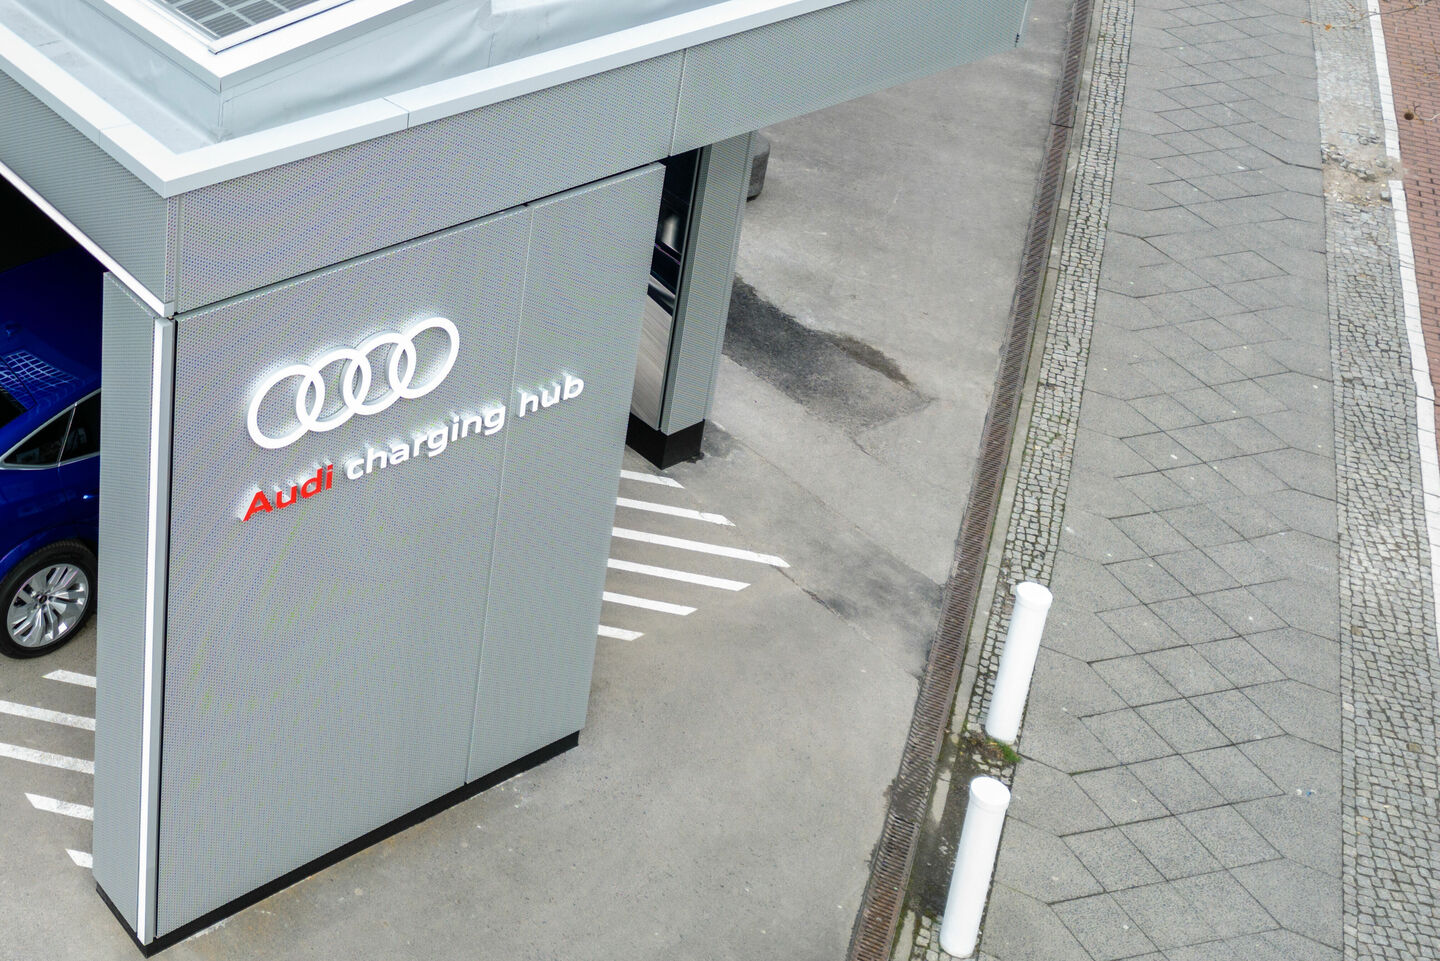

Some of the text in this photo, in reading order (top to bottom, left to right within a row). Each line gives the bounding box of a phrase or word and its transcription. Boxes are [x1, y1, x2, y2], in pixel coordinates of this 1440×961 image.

[242, 372, 585, 522] Audi charging hub
